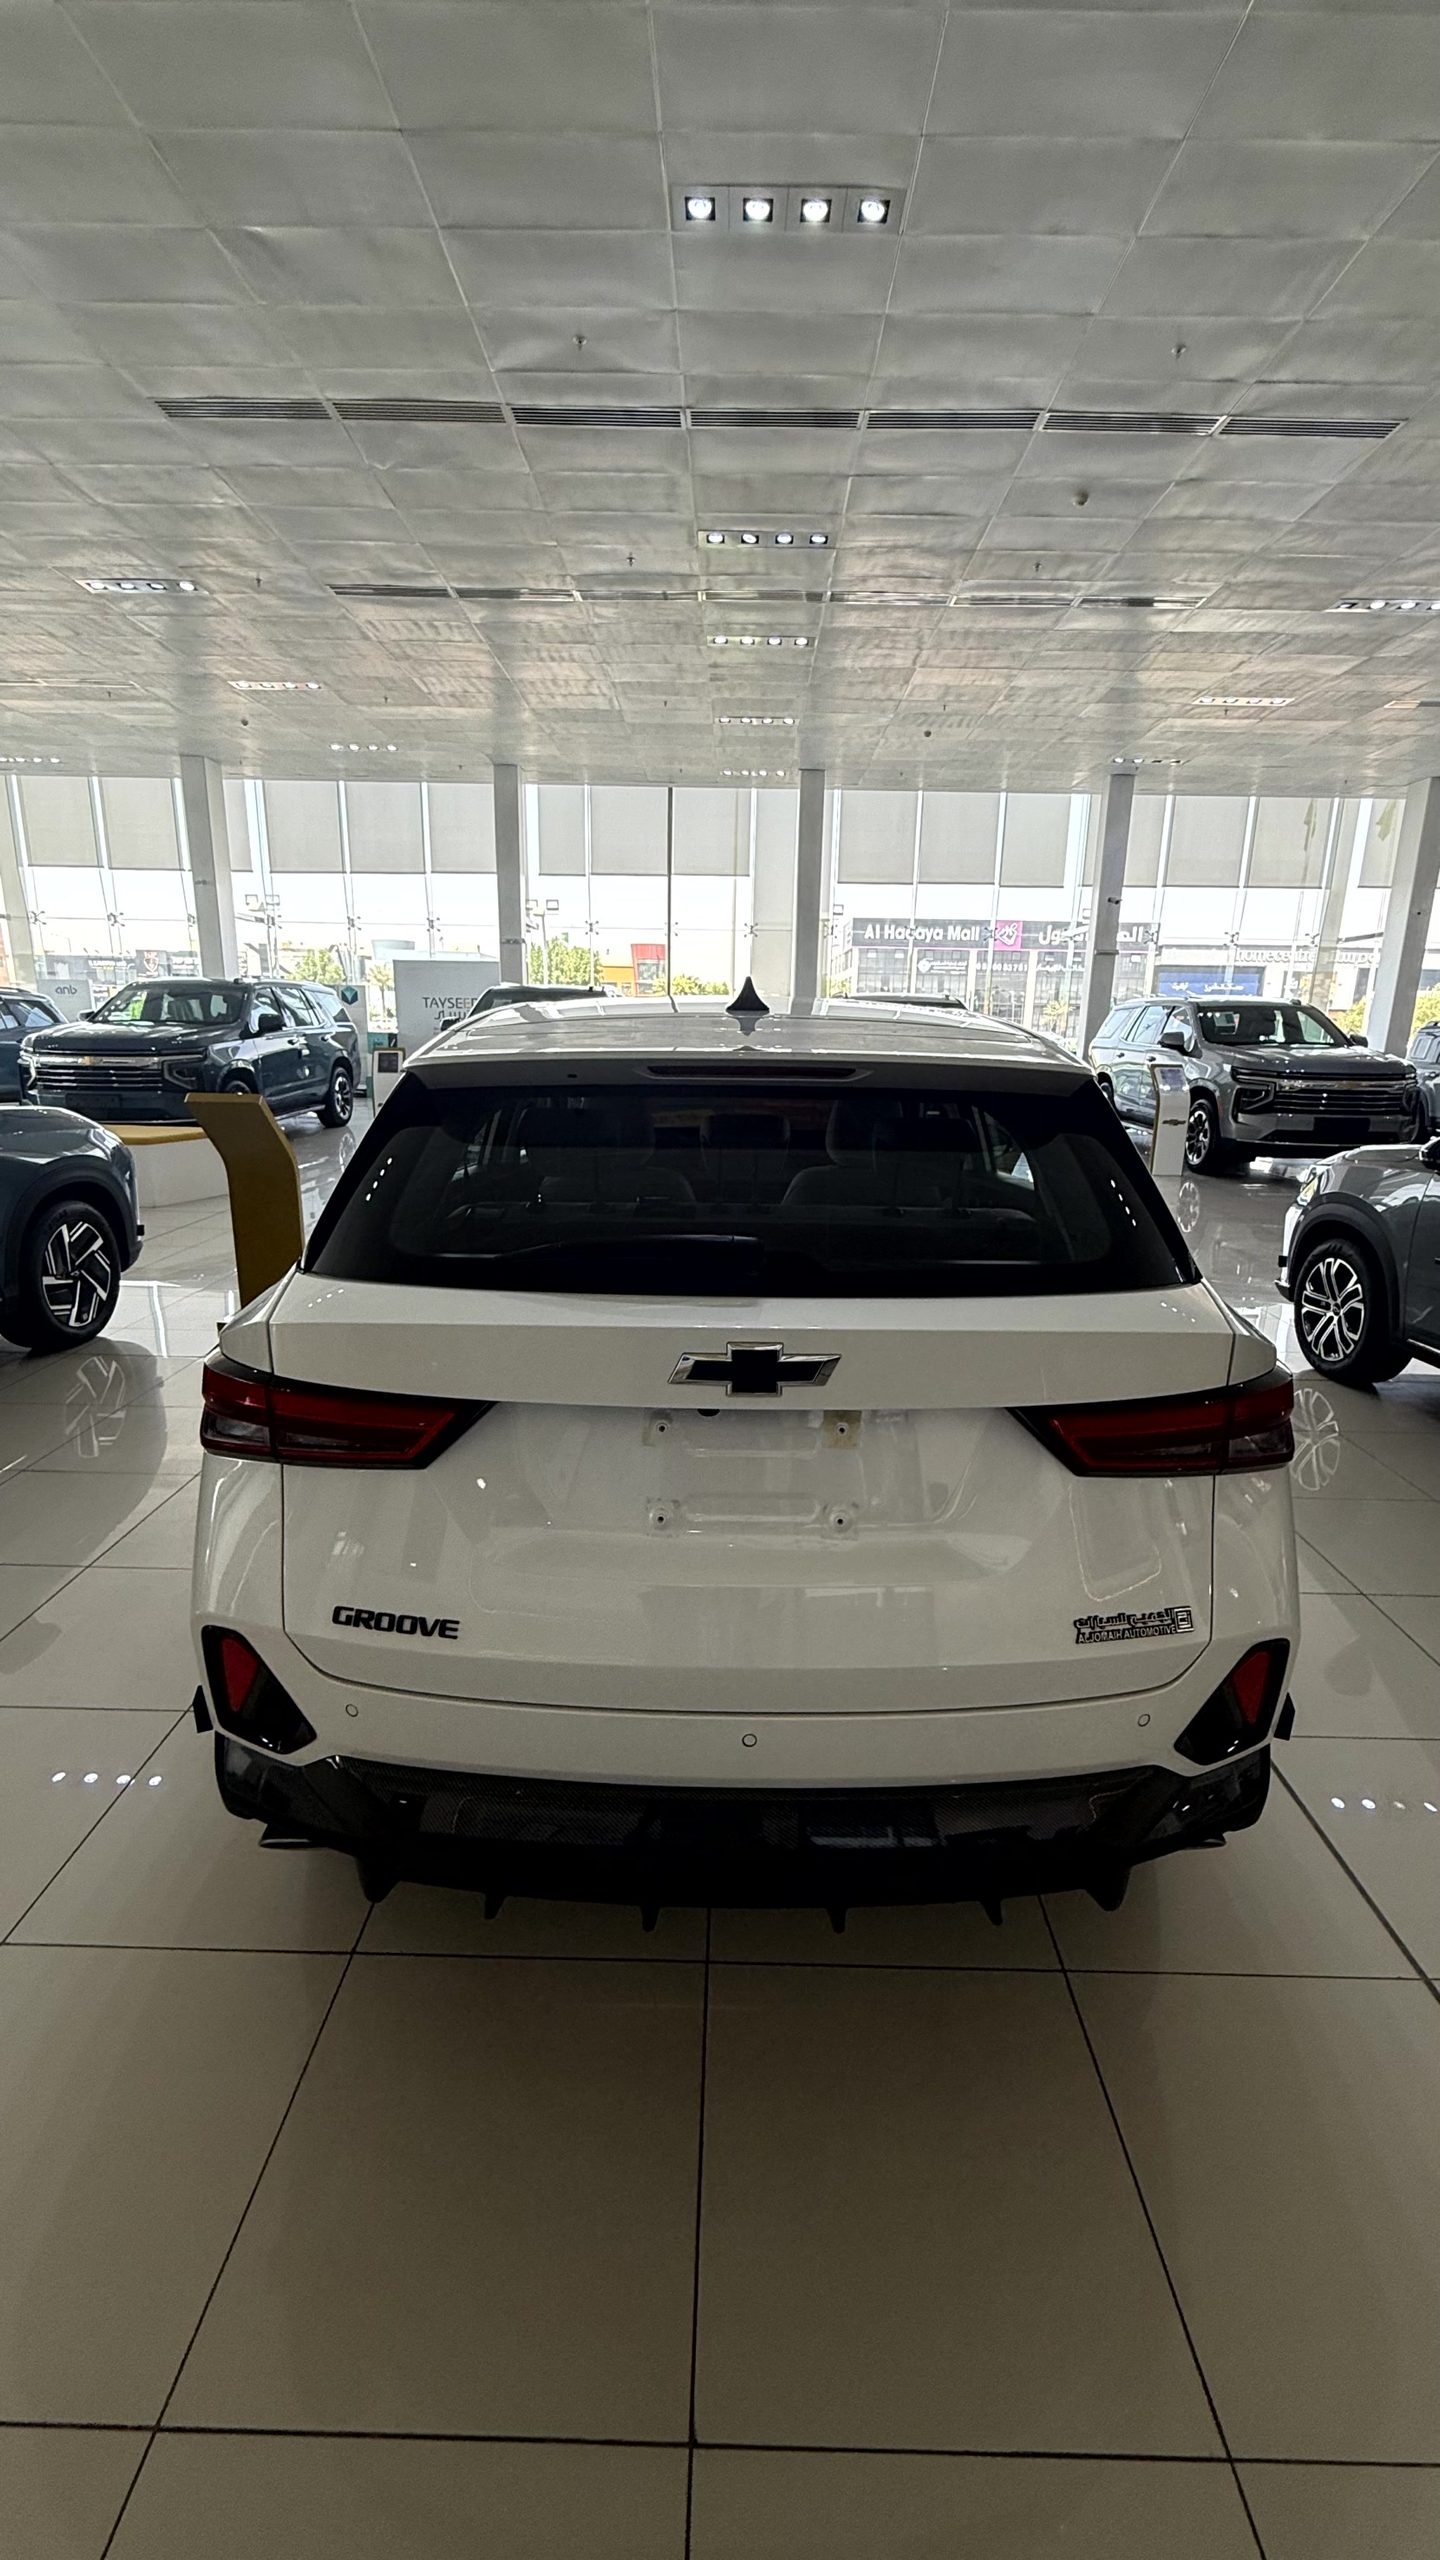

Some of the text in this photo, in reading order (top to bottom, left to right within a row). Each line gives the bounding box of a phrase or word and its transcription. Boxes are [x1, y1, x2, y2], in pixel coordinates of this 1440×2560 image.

[864, 923, 880, 940] Al
[947, 925, 980, 941] Mall
[55, 984, 78, 995] anb
[332, 1605, 460, 1640] GROOVE
[1123, 1624, 1176, 1640] AUTOMOTIVE
